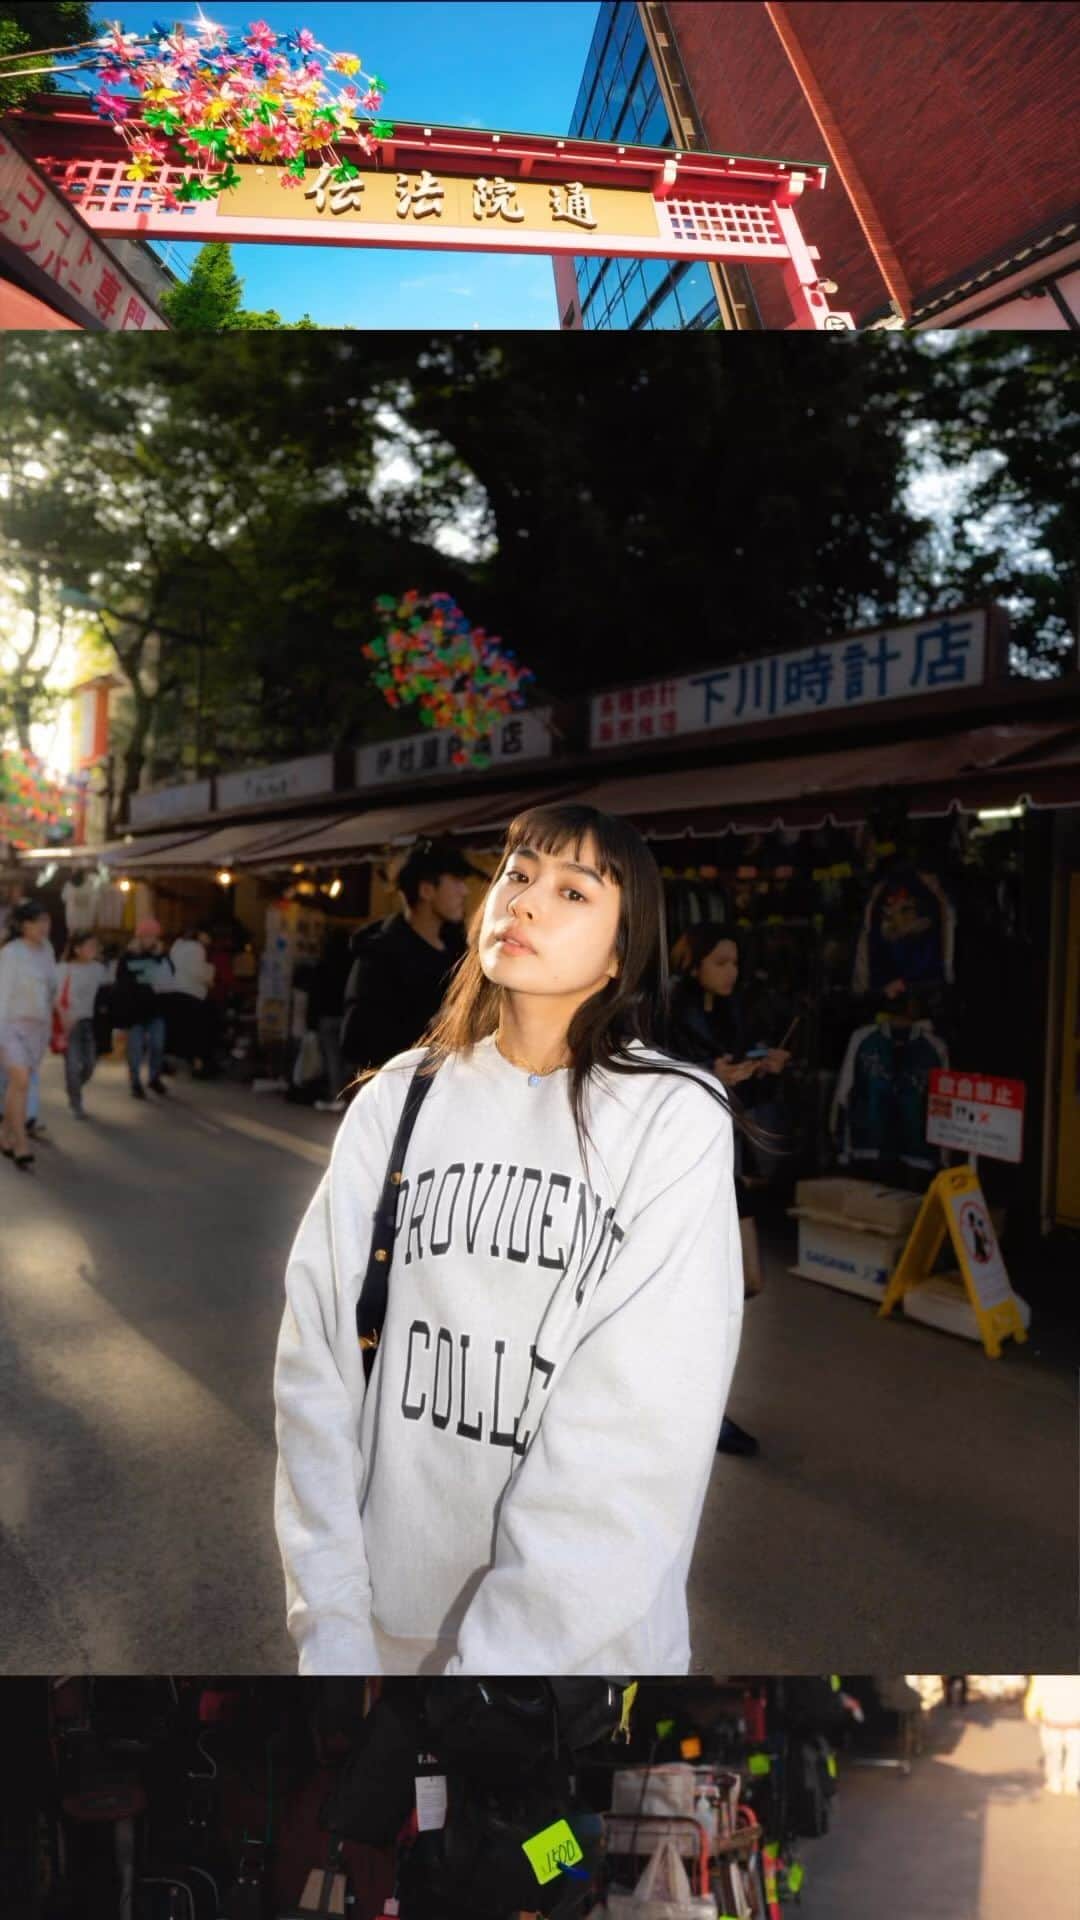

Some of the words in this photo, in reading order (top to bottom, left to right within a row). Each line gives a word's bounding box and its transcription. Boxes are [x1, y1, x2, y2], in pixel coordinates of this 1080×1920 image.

[305, 163, 598, 230] 伝法院通
[692, 618, 973, 724] 下川時計店
